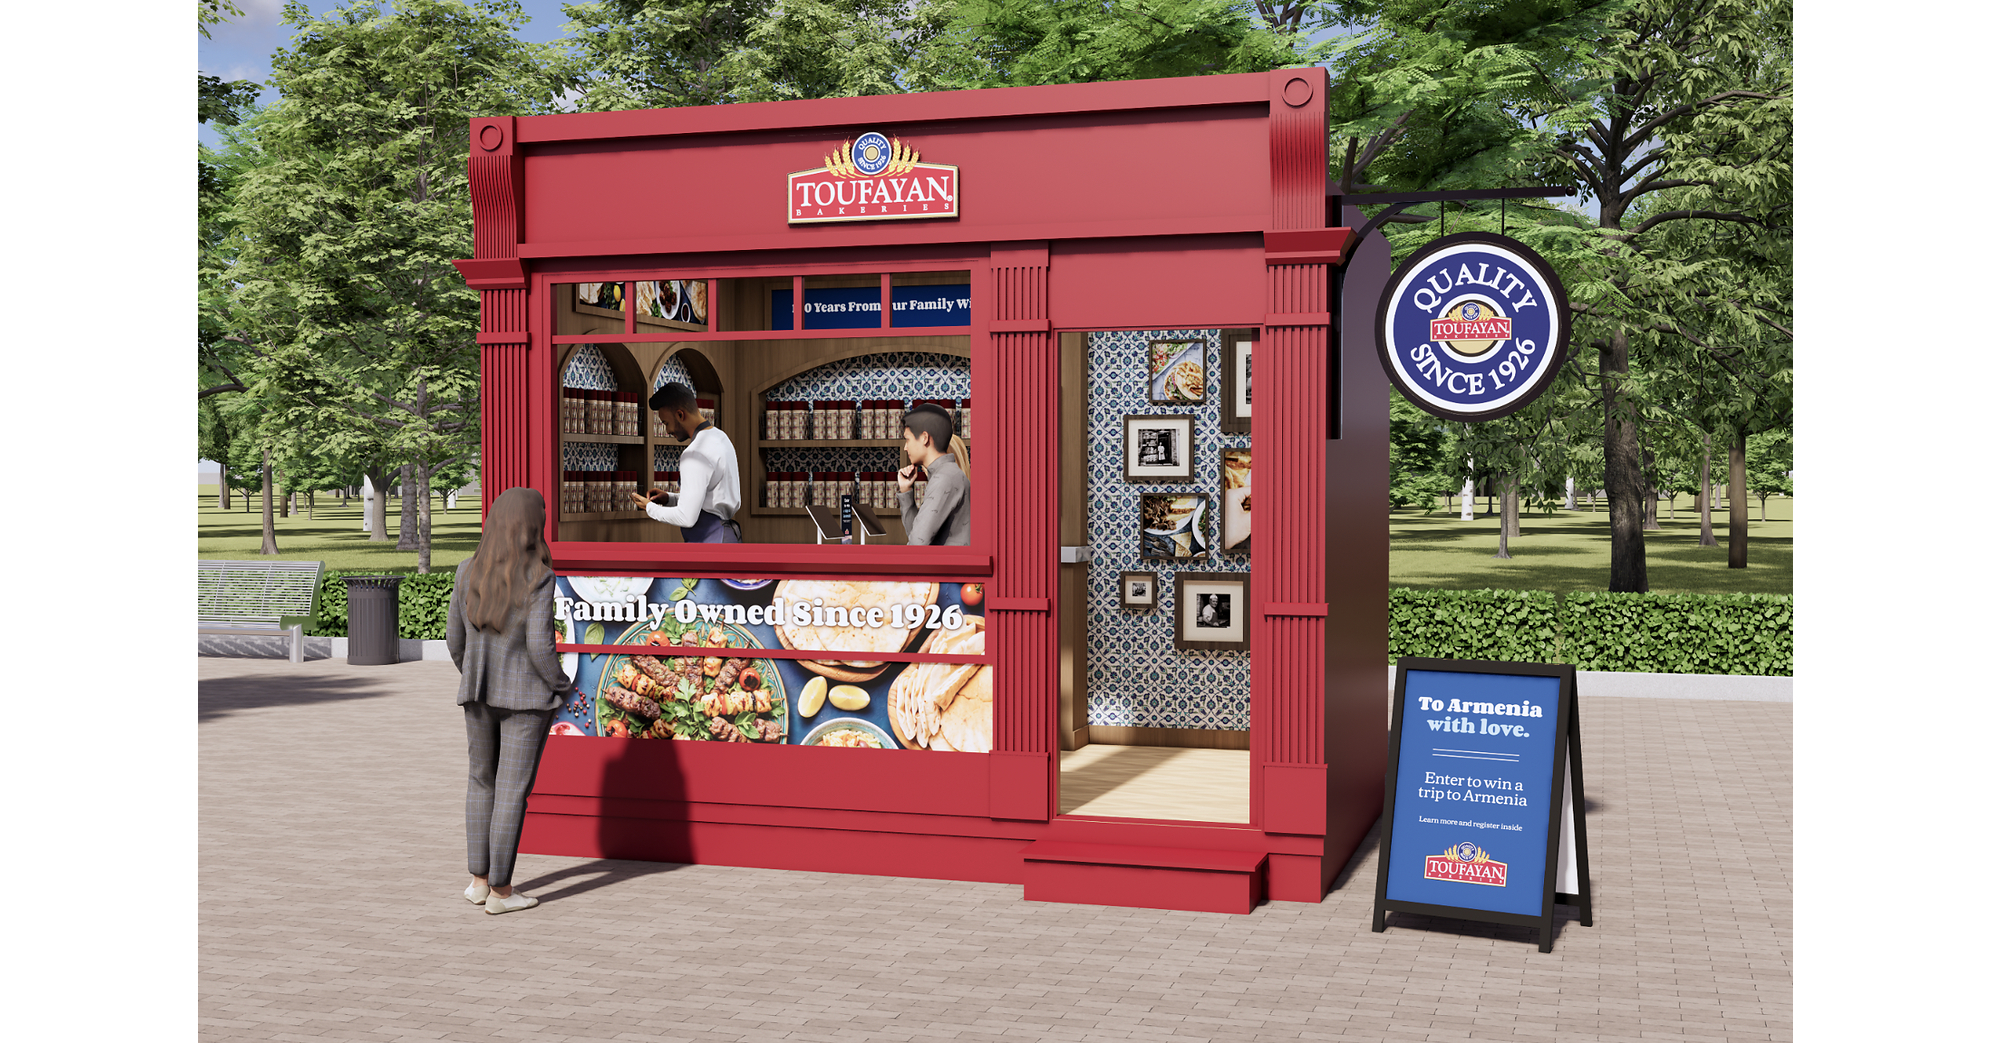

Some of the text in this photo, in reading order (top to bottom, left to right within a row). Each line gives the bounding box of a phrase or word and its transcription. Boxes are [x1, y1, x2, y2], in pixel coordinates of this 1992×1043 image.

[858, 137, 887, 150] QUALITY
[796, 175, 949, 207] TOUFAYAN
[796, 203, 950, 216] BAKERIES
[1413, 262, 1538, 314] QUALITY
[814, 302, 846, 312] Years
[848, 301, 881, 312] From
[909, 297, 954, 312] Family
[1434, 322, 1508, 334] TOUFAYAN
[1410, 337, 1536, 396] SINCE 1926
[553, 594, 964, 631] Family Owned Since 1926
[1418, 696, 1543, 718] To Armenia
[1426, 715, 1530, 738] with love.
[1424, 771, 1524, 792] Enter to win a
[1418, 787, 1528, 807] trip to Armenia
[1419, 815, 1523, 832] Learn more and register inside
[1429, 860, 1504, 879] TOUFAYAN
